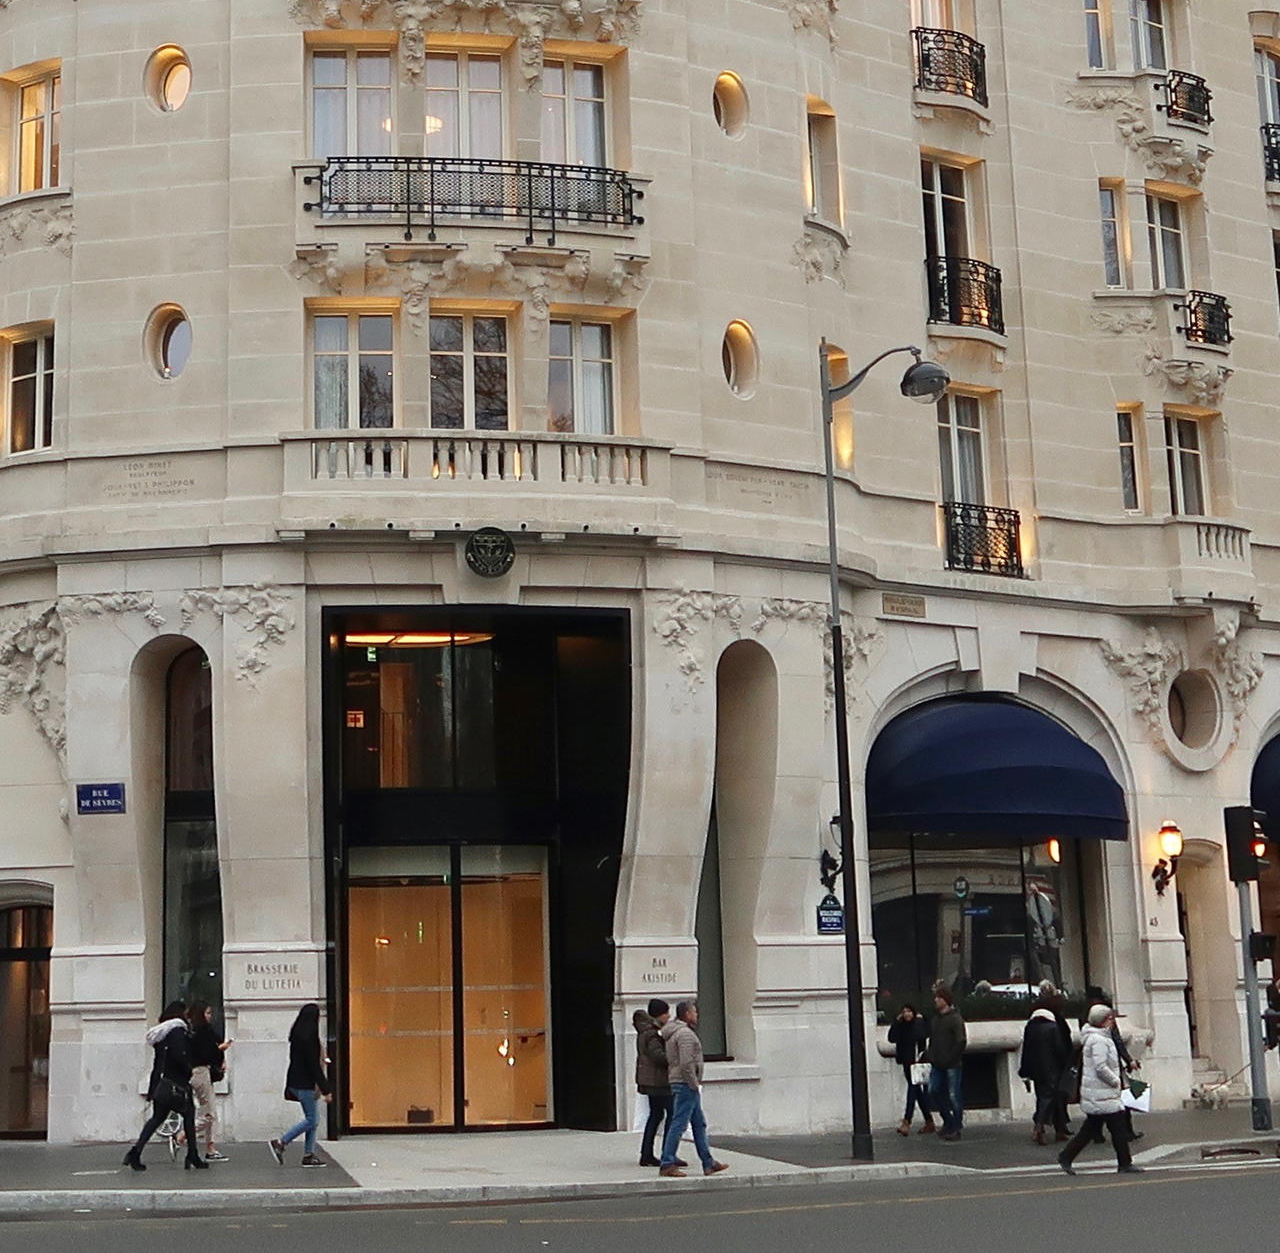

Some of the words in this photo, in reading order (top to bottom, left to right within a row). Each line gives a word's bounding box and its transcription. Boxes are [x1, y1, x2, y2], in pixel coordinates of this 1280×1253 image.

[91, 789, 110, 797] RUE
[247, 963, 299, 975] BRASSERIE
[245, 979, 258, 990] DU
[263, 978, 301, 990] LUTETIA
